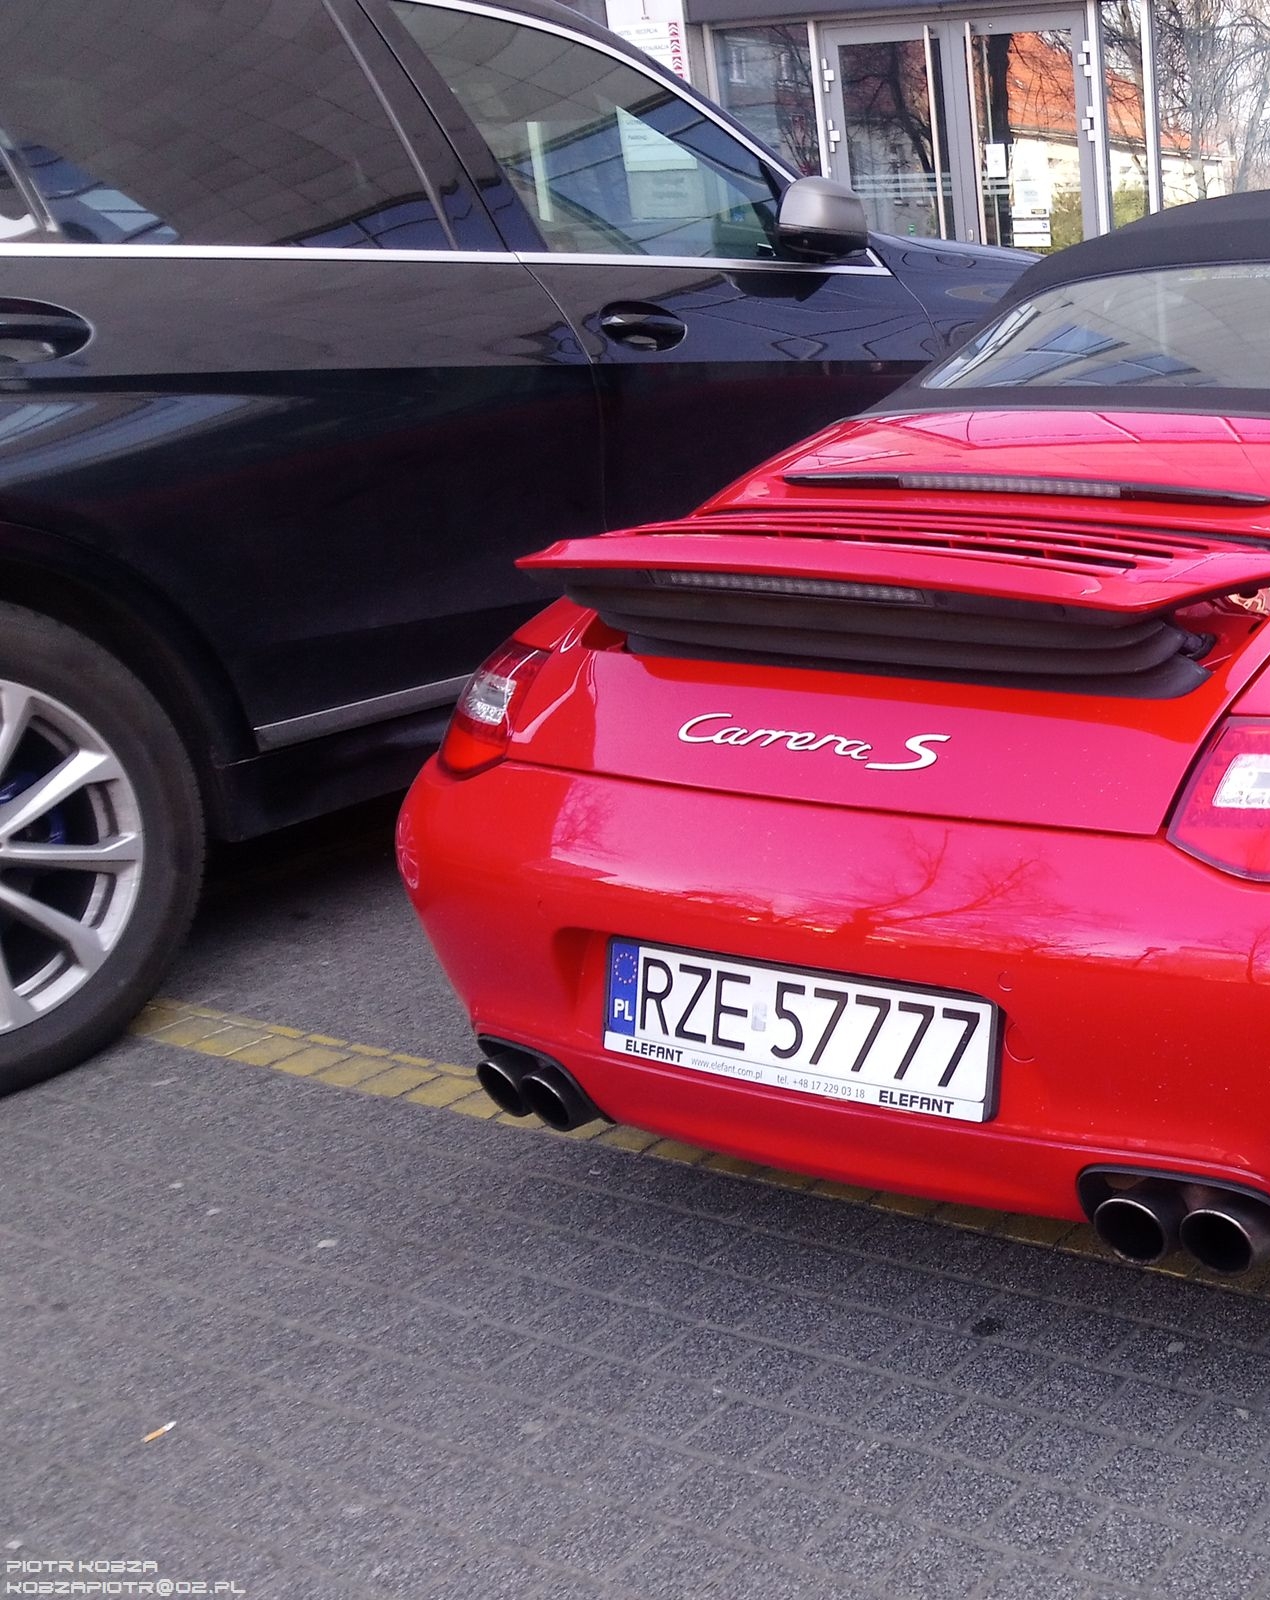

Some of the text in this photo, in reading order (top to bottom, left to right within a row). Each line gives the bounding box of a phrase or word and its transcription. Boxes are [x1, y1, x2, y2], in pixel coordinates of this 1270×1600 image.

[678, 712, 951, 772] Carrera S
[613, 998, 634, 1021] PL
[639, 956, 981, 1088] RZE 57777
[625, 1039, 955, 1114] ELEFANT www.elefant.com.pl tel. +48 17 229 03 18 ELEFANT
